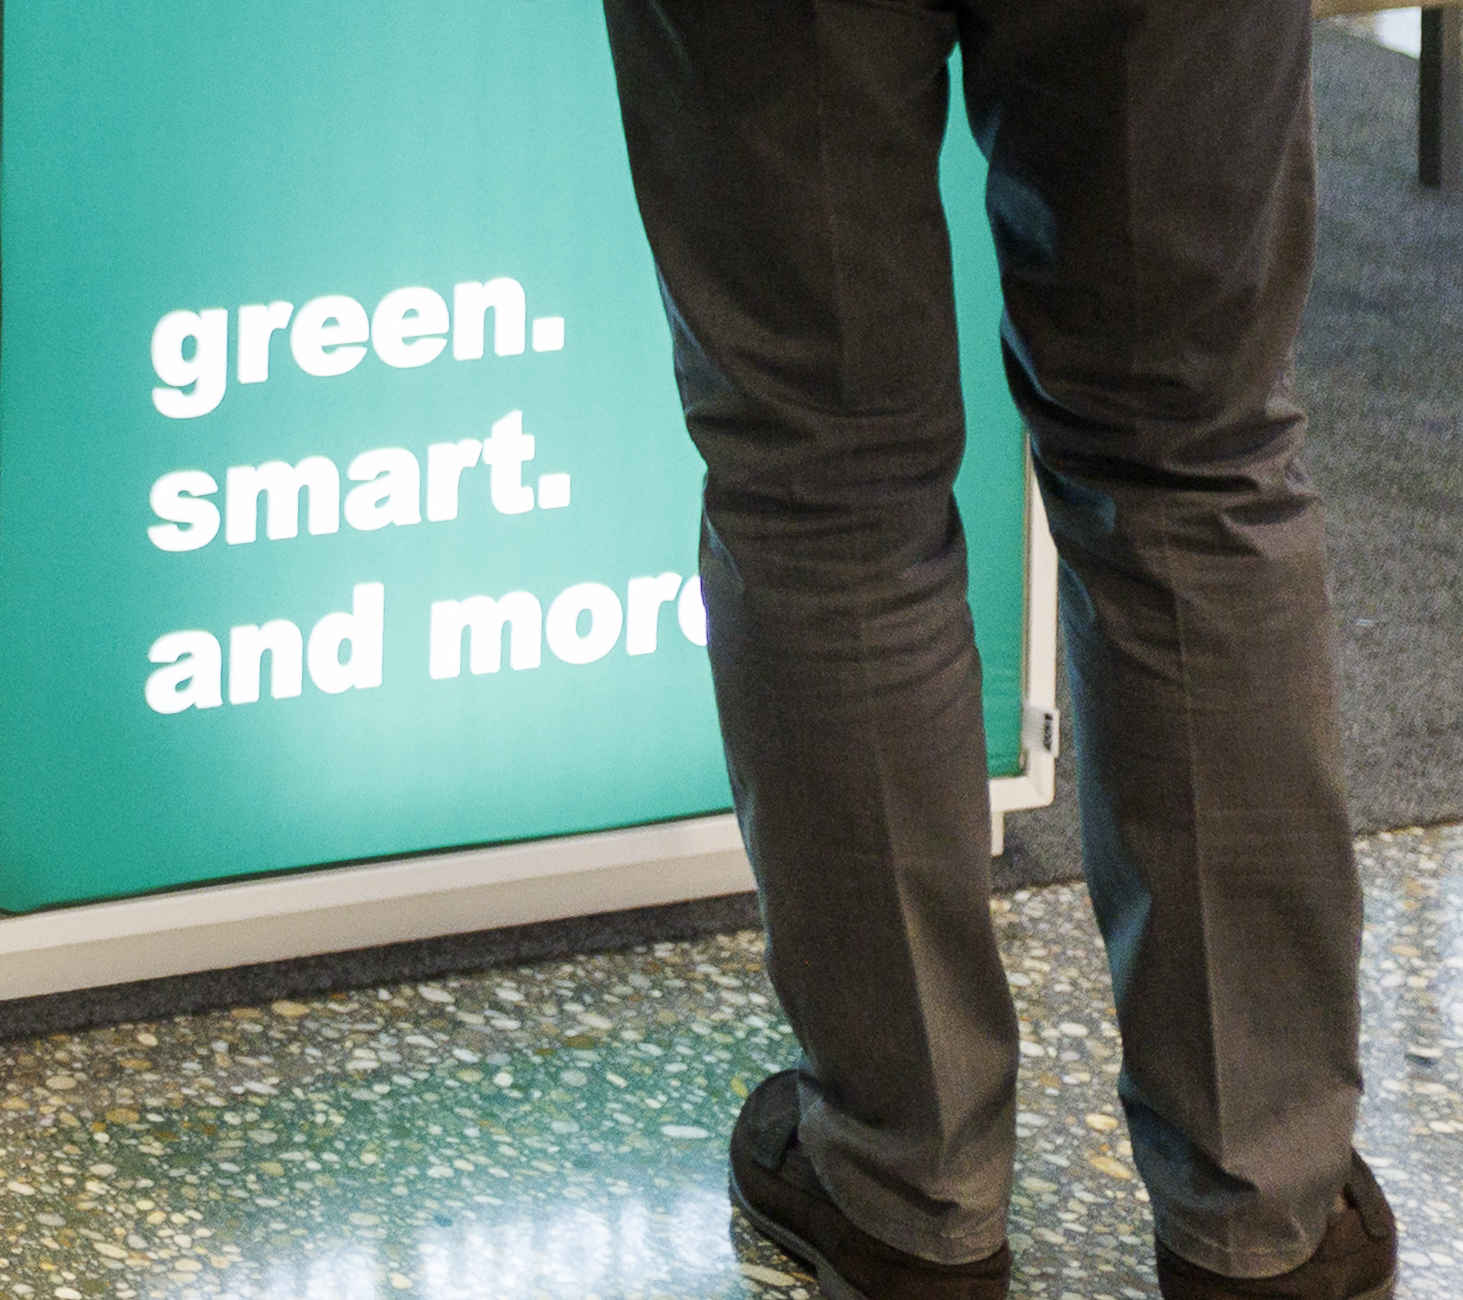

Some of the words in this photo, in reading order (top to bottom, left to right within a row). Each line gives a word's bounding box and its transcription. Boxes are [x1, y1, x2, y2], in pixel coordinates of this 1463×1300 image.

[148, 274, 566, 420] green.
[145, 409, 572, 553] smart.
[143, 581, 385, 716] and
